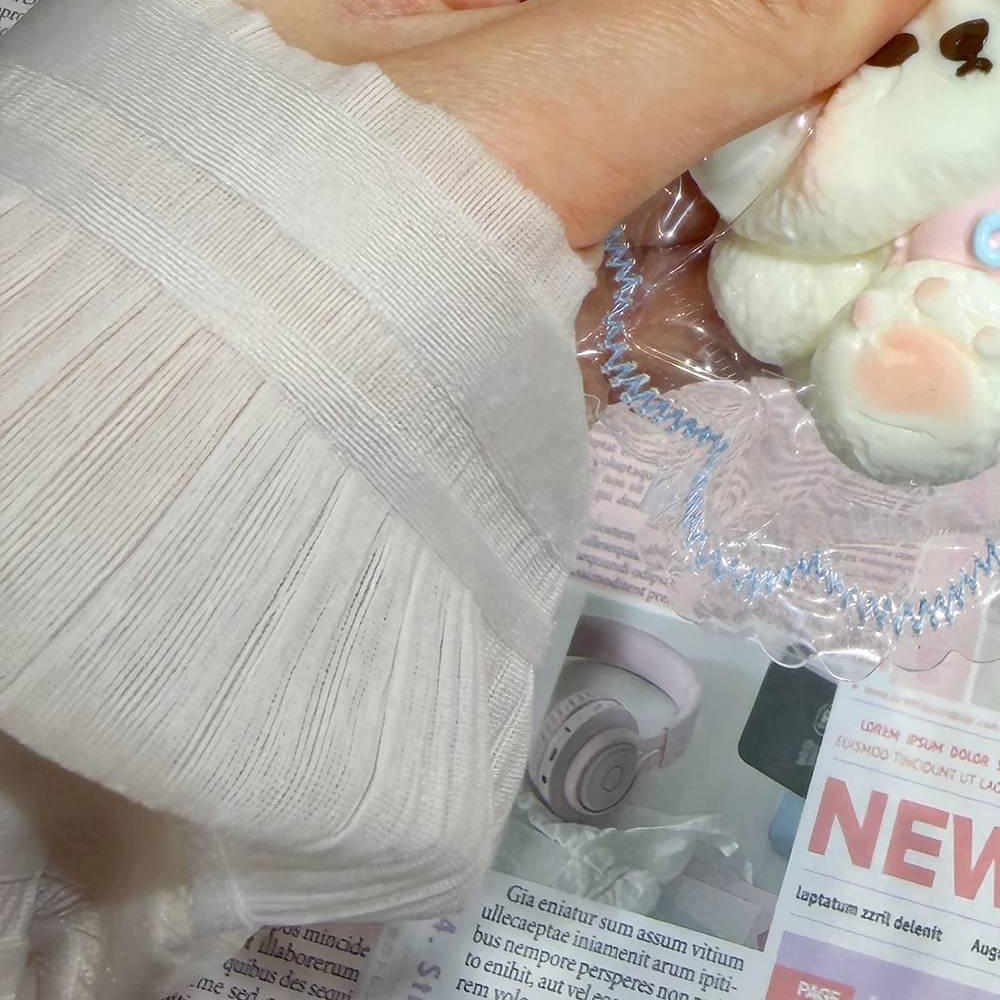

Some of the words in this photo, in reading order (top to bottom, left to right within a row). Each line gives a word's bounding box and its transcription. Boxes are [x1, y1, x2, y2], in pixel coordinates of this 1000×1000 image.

[907, 733, 943, 754] IPSUM
[258, 929, 361, 982] illaborerum
[472, 924, 502, 949] bus
[504, 938, 577, 977] nempore
[577, 961, 654, 996] persperes
[480, 903, 571, 945] ullecaeptae
[573, 929, 650, 969] iniamenit
[652, 955, 696, 982] arum
[538, 898, 599, 927] eniatur
[599, 915, 633, 938] sum
[637, 927, 687, 953] assum
[691, 941, 744, 971] vitium
[280, 970, 307, 993] des
[464, 952, 481, 970] to
[538, 974, 564, 995] aut
